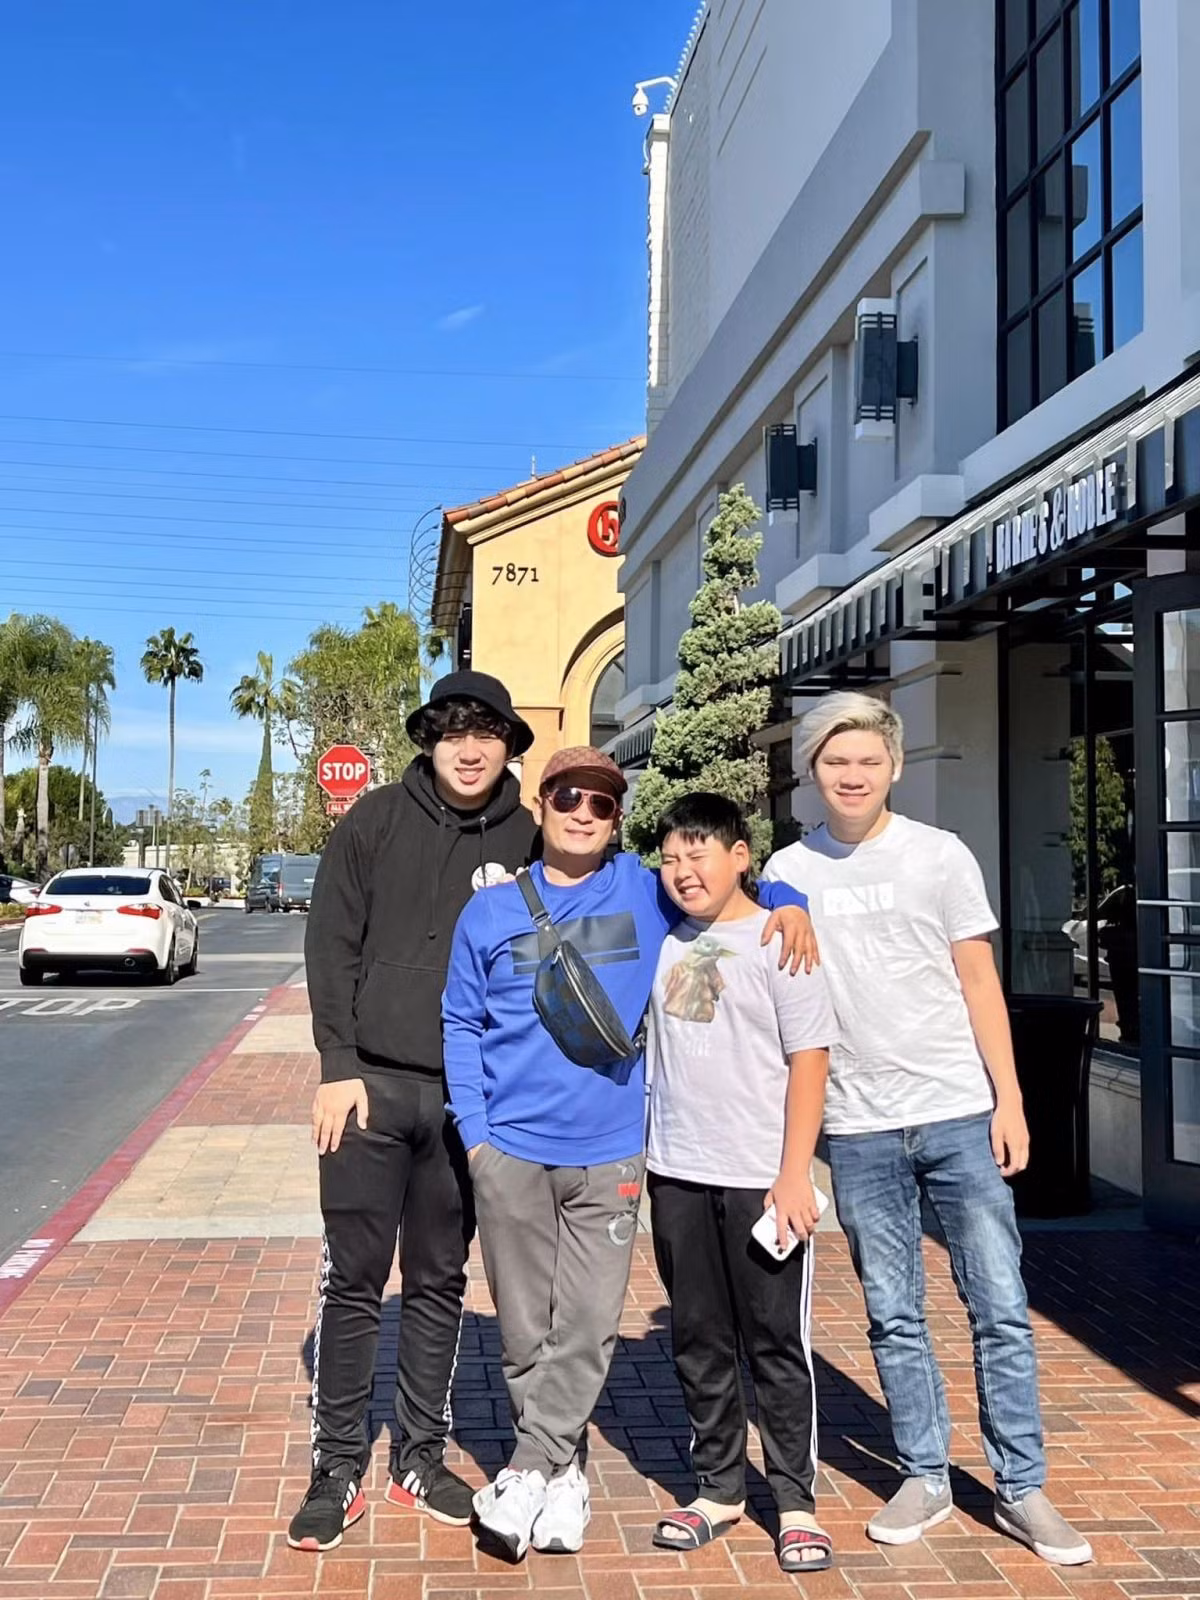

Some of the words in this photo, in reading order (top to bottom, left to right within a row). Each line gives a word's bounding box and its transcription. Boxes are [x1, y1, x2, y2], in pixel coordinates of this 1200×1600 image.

[1050, 487, 1066, 551] &
[492, 563, 539, 586] 7871
[322, 762, 366, 781] STOP
